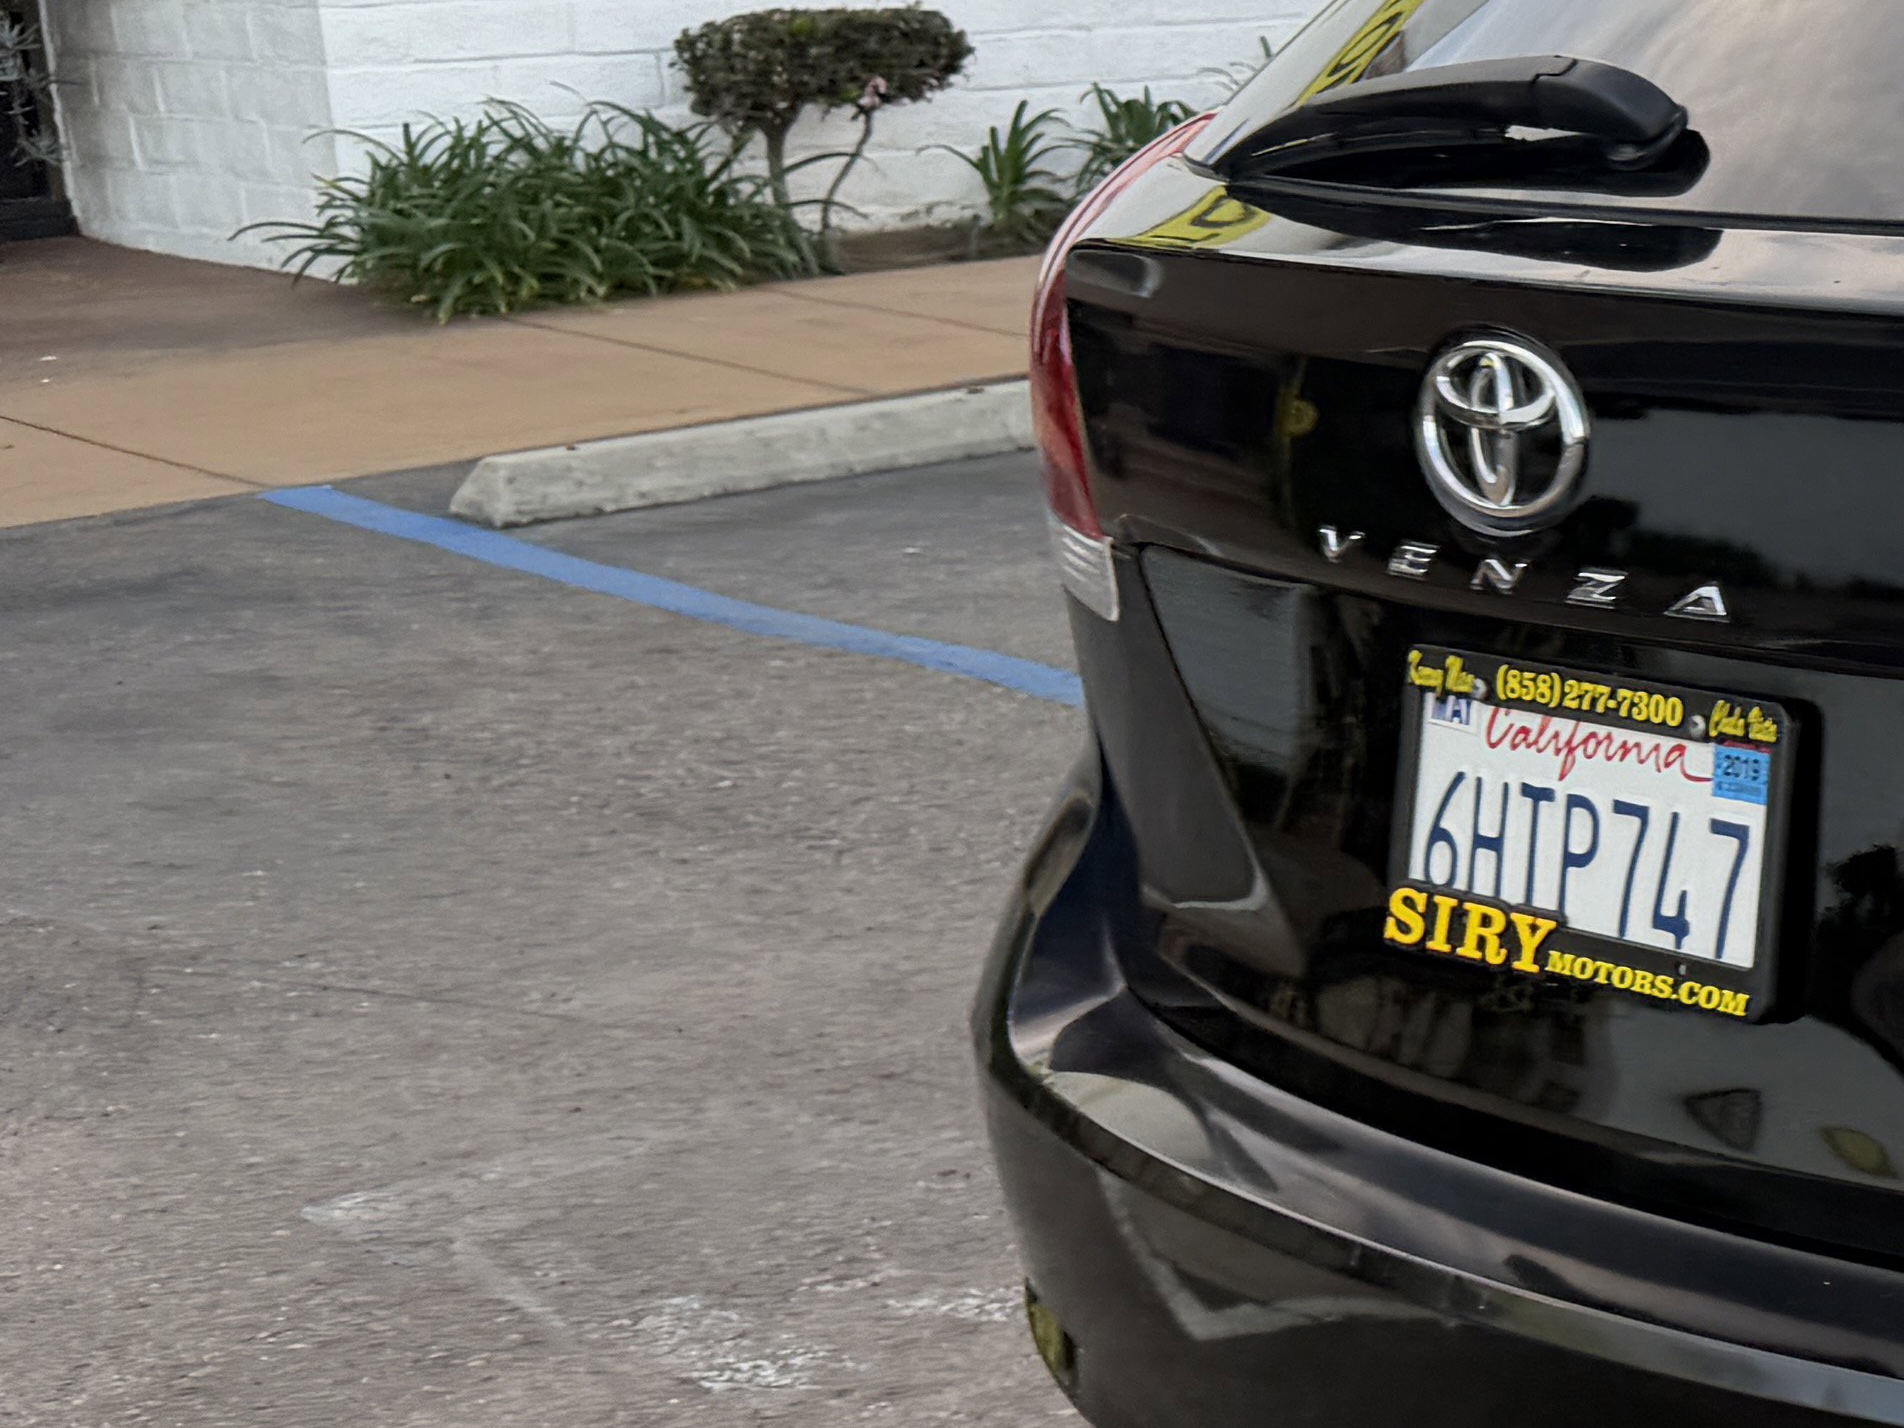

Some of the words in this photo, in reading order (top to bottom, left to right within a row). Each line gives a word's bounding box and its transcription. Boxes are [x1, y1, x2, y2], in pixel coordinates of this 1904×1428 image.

[1317, 524, 1731, 623] VENZA
[1485, 707, 1712, 782] California
[1424, 771, 1750, 960] 6HTP747
[1383, 887, 1556, 973] SIRY
[1545, 950, 1750, 1016] MOTORS.COM
